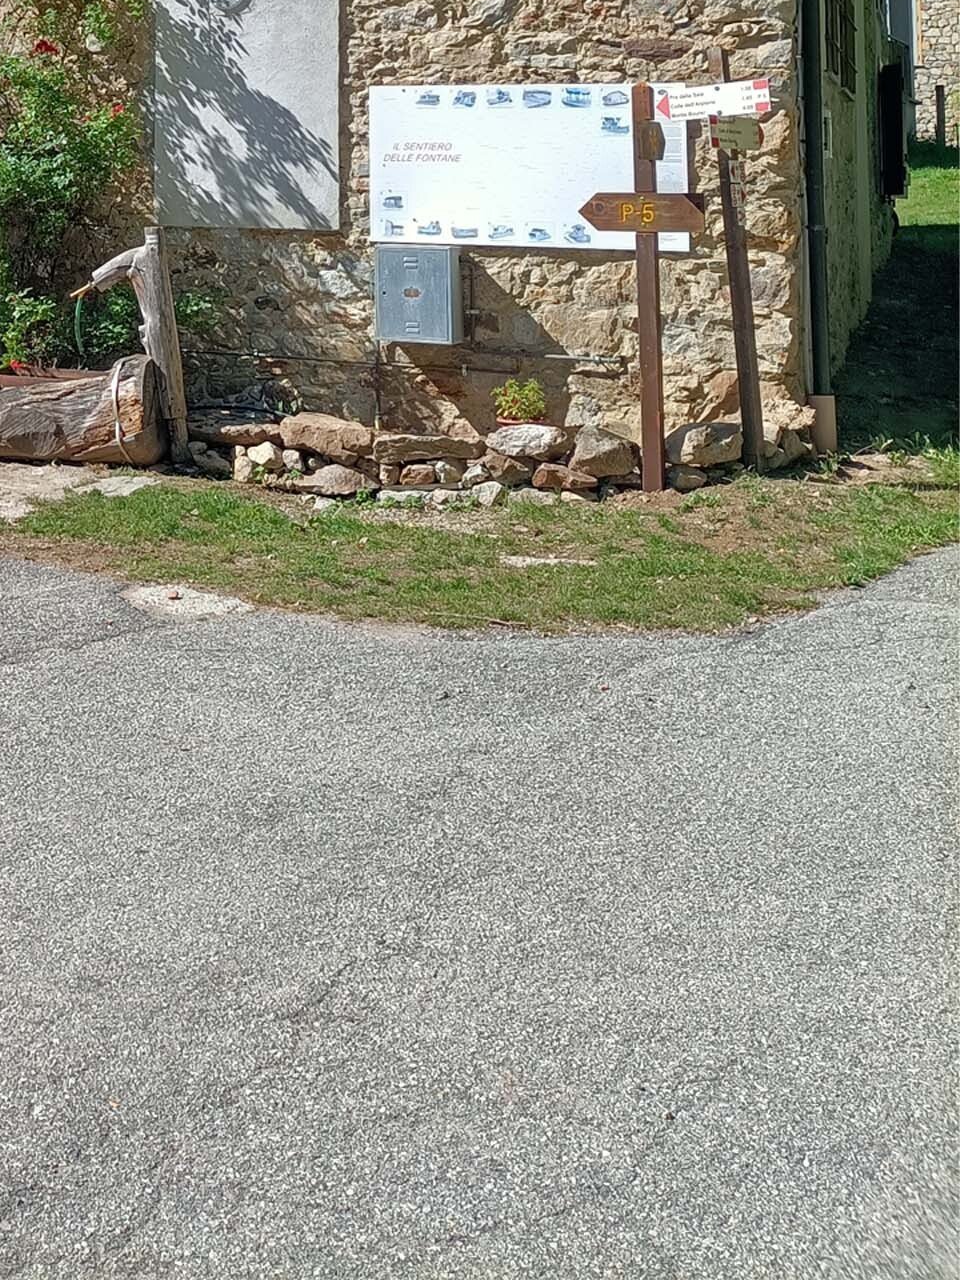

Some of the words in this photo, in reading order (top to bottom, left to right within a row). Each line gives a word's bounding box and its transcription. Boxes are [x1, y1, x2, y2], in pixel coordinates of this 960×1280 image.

[392, 142, 401, 152] IL
[403, 142, 453, 152] SENTIERO
[383, 153, 414, 163] DELLE
[416, 153, 463, 163] FONTANE
[620, 202, 655, 223] P-5
